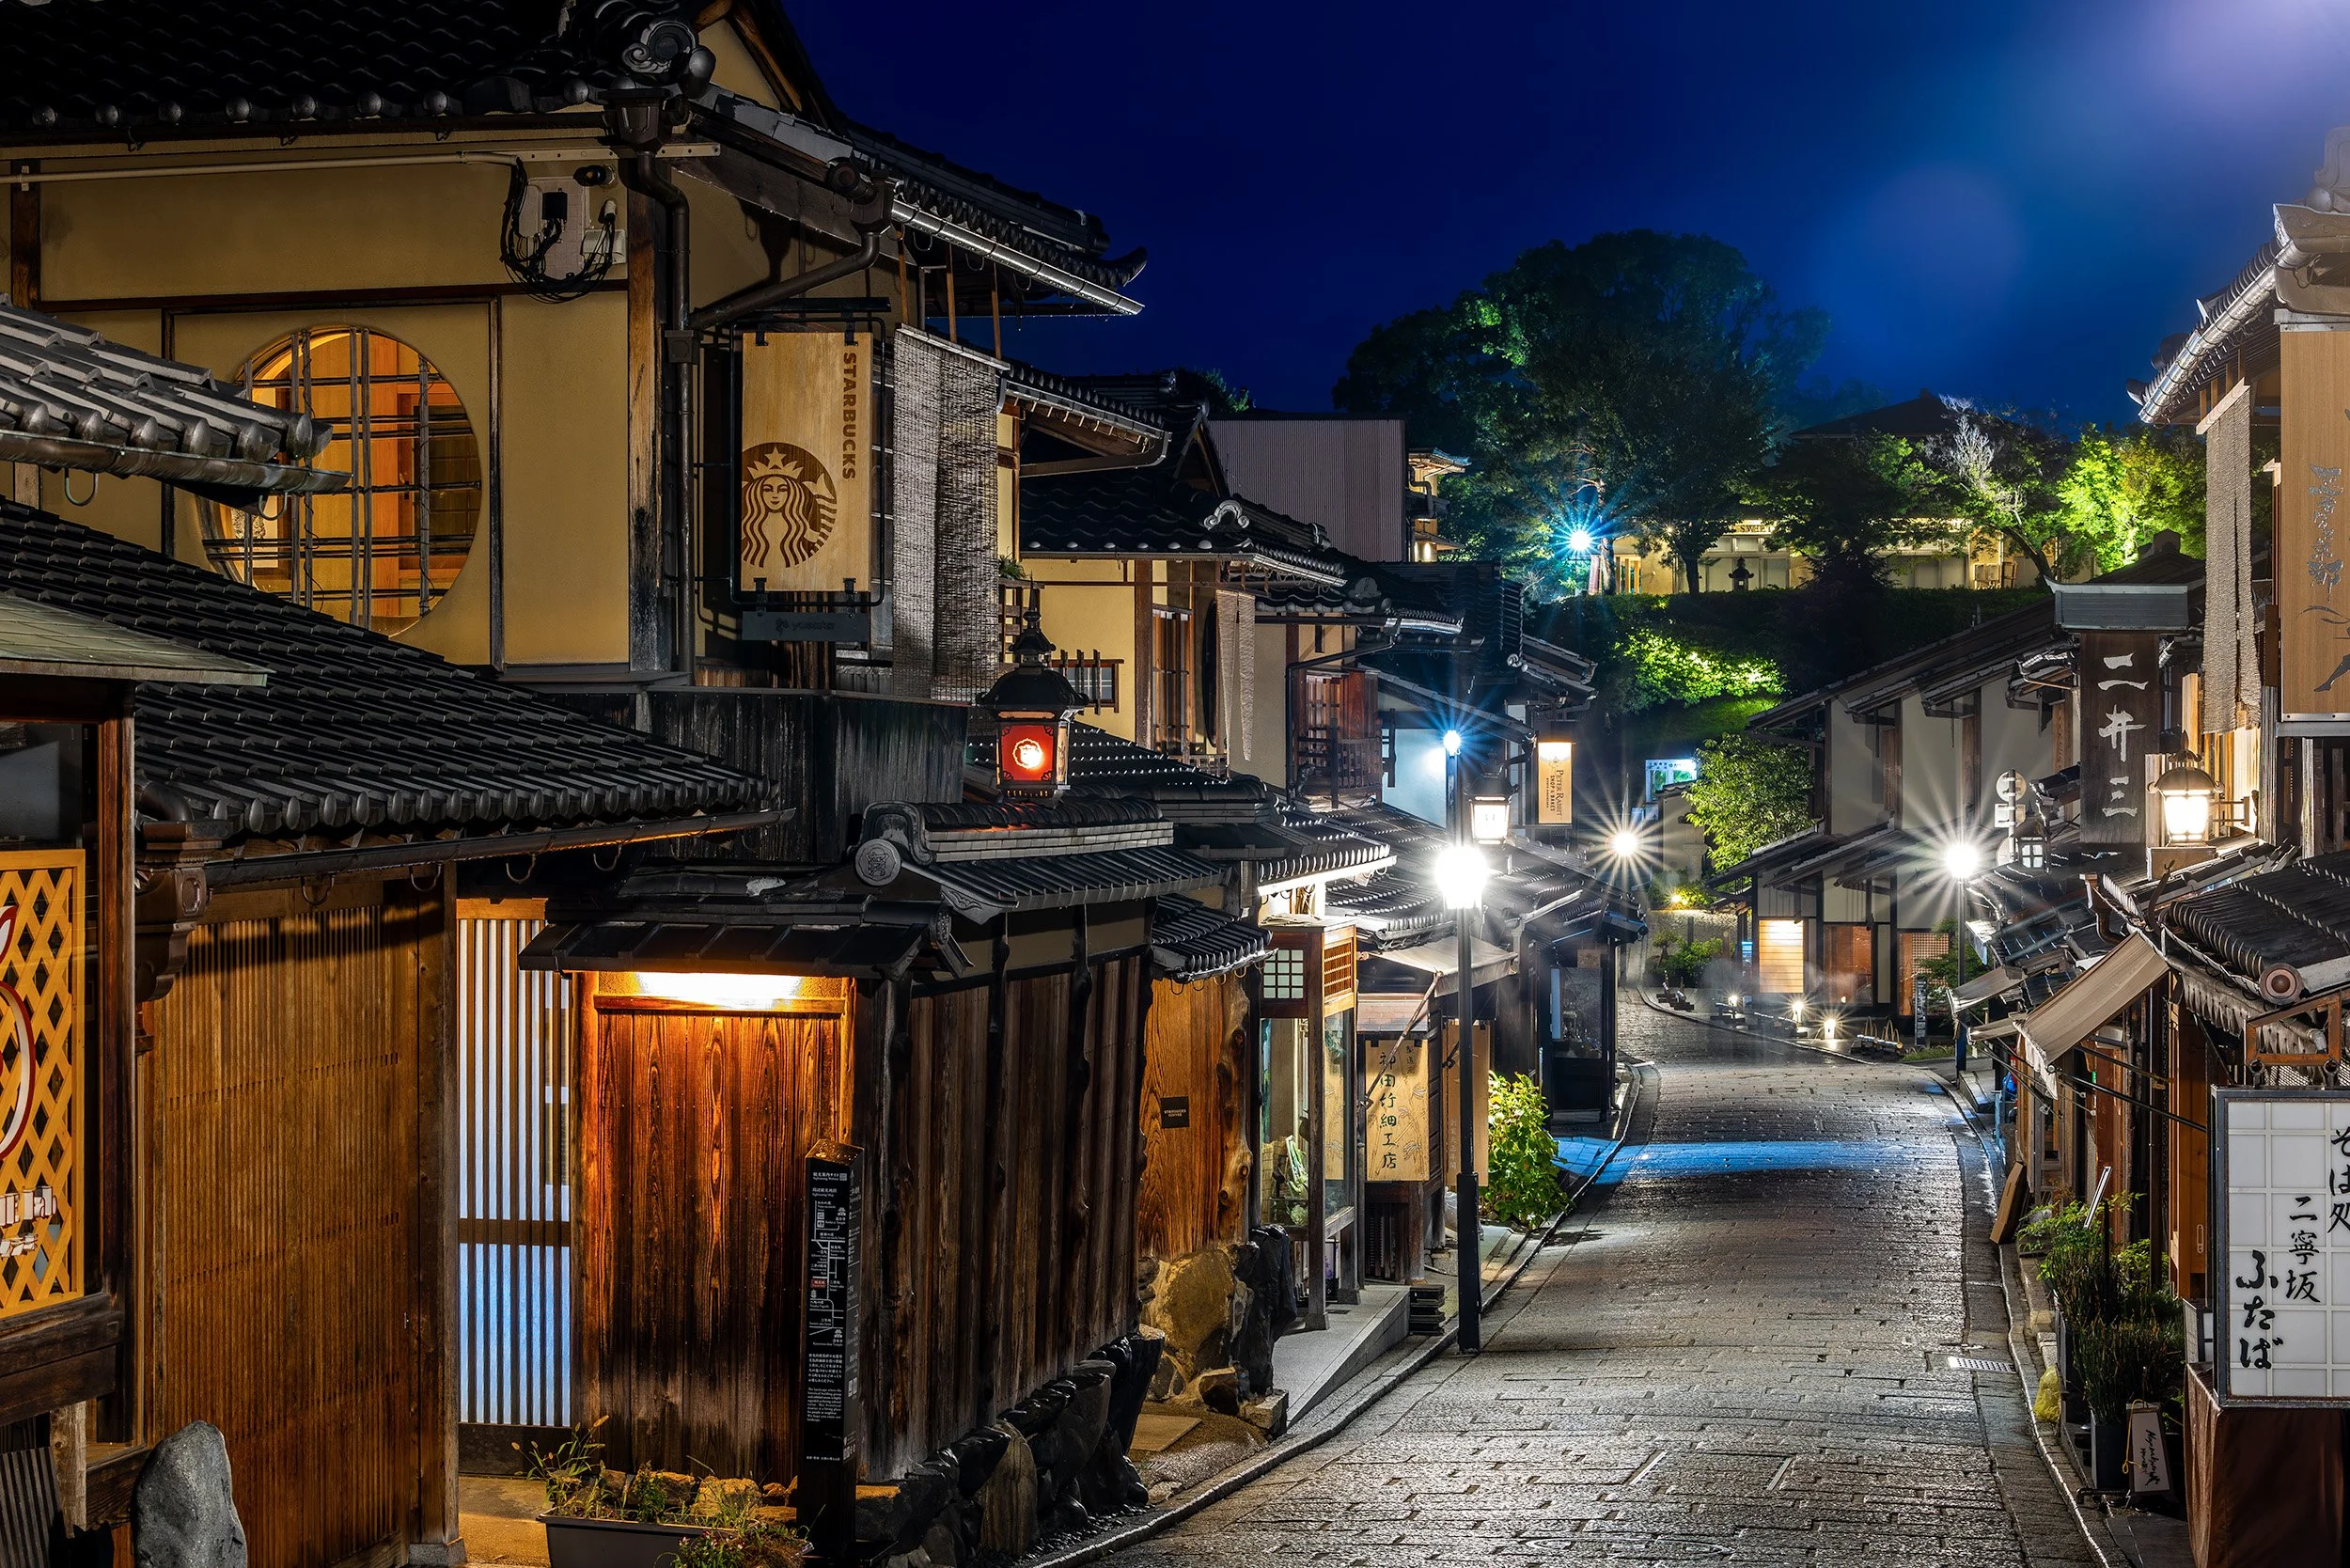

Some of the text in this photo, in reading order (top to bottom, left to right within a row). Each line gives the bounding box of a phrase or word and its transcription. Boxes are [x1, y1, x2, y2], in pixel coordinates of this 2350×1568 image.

[842, 353, 857, 479] STARBUCKS
[2236, 1249, 2284, 1370] ふたば
[2285, 1196, 2321, 1303] 二寧坂
